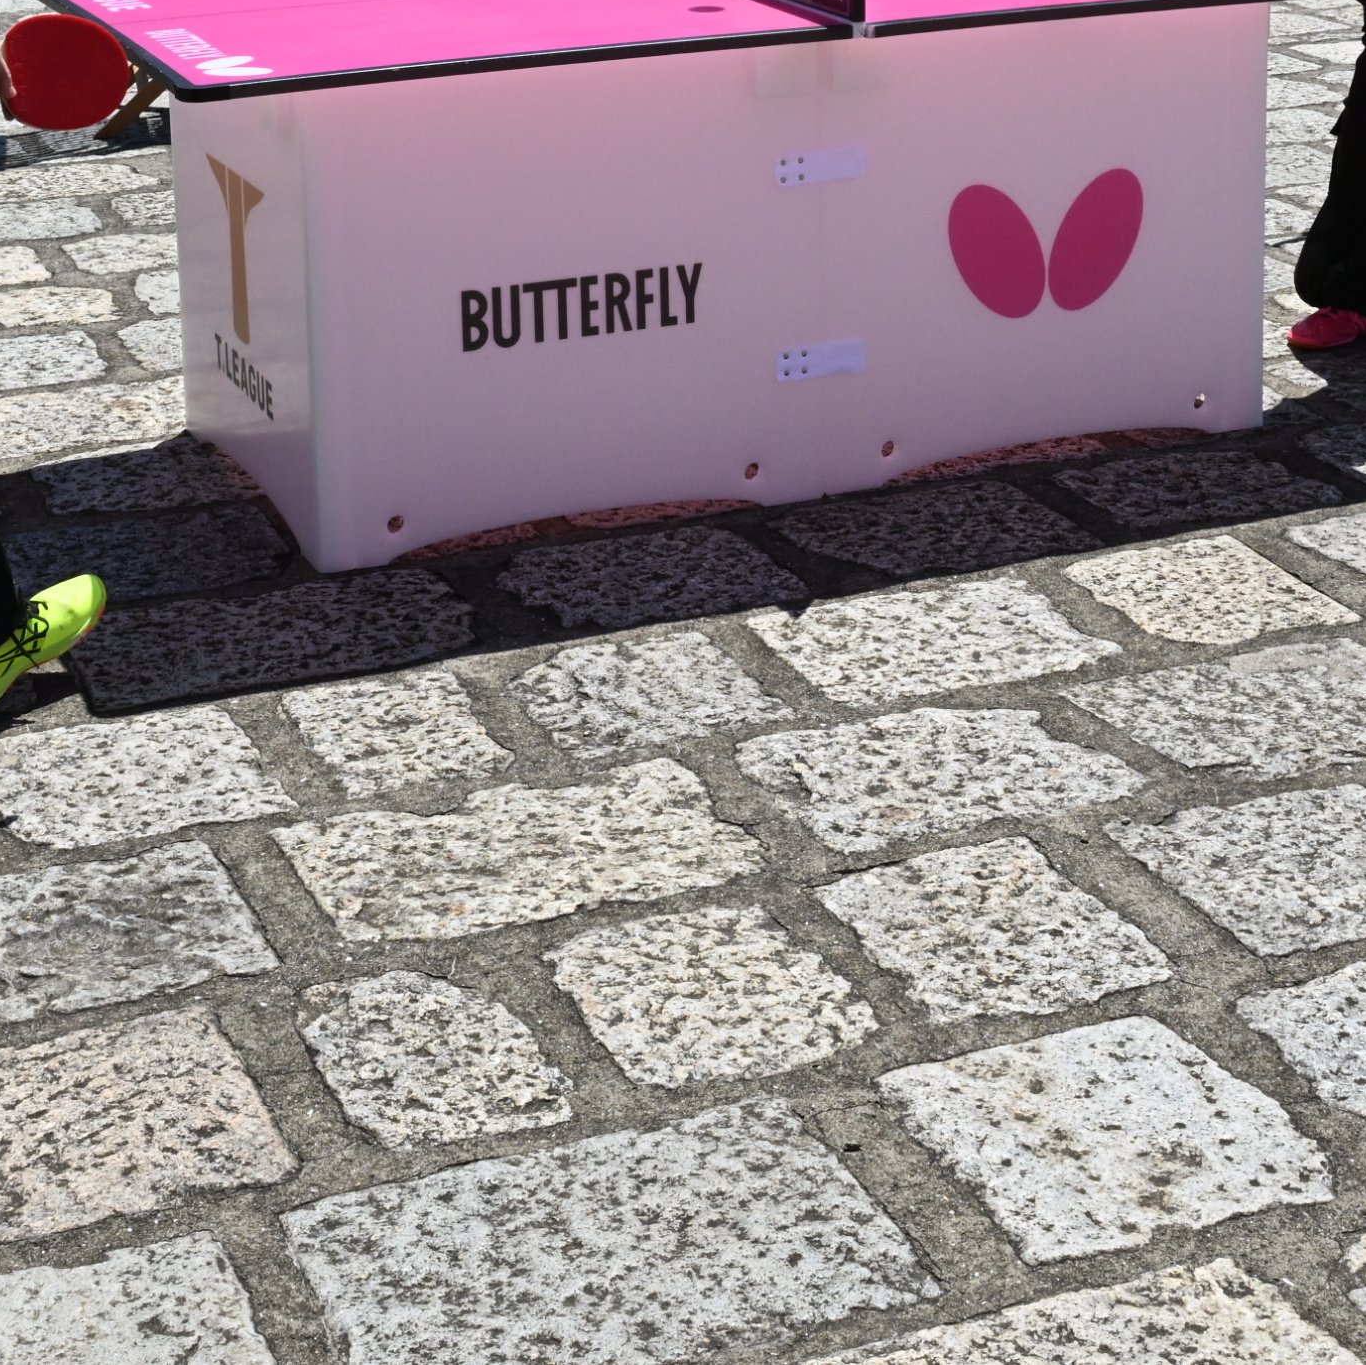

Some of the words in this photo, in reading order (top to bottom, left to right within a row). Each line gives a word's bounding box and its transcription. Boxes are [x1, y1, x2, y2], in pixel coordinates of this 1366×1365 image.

[144, 27, 228, 60] BUTTERFLY
[461, 262, 703, 352] BUTTERFLY
[214, 332, 274, 421] T.LEAGUE
